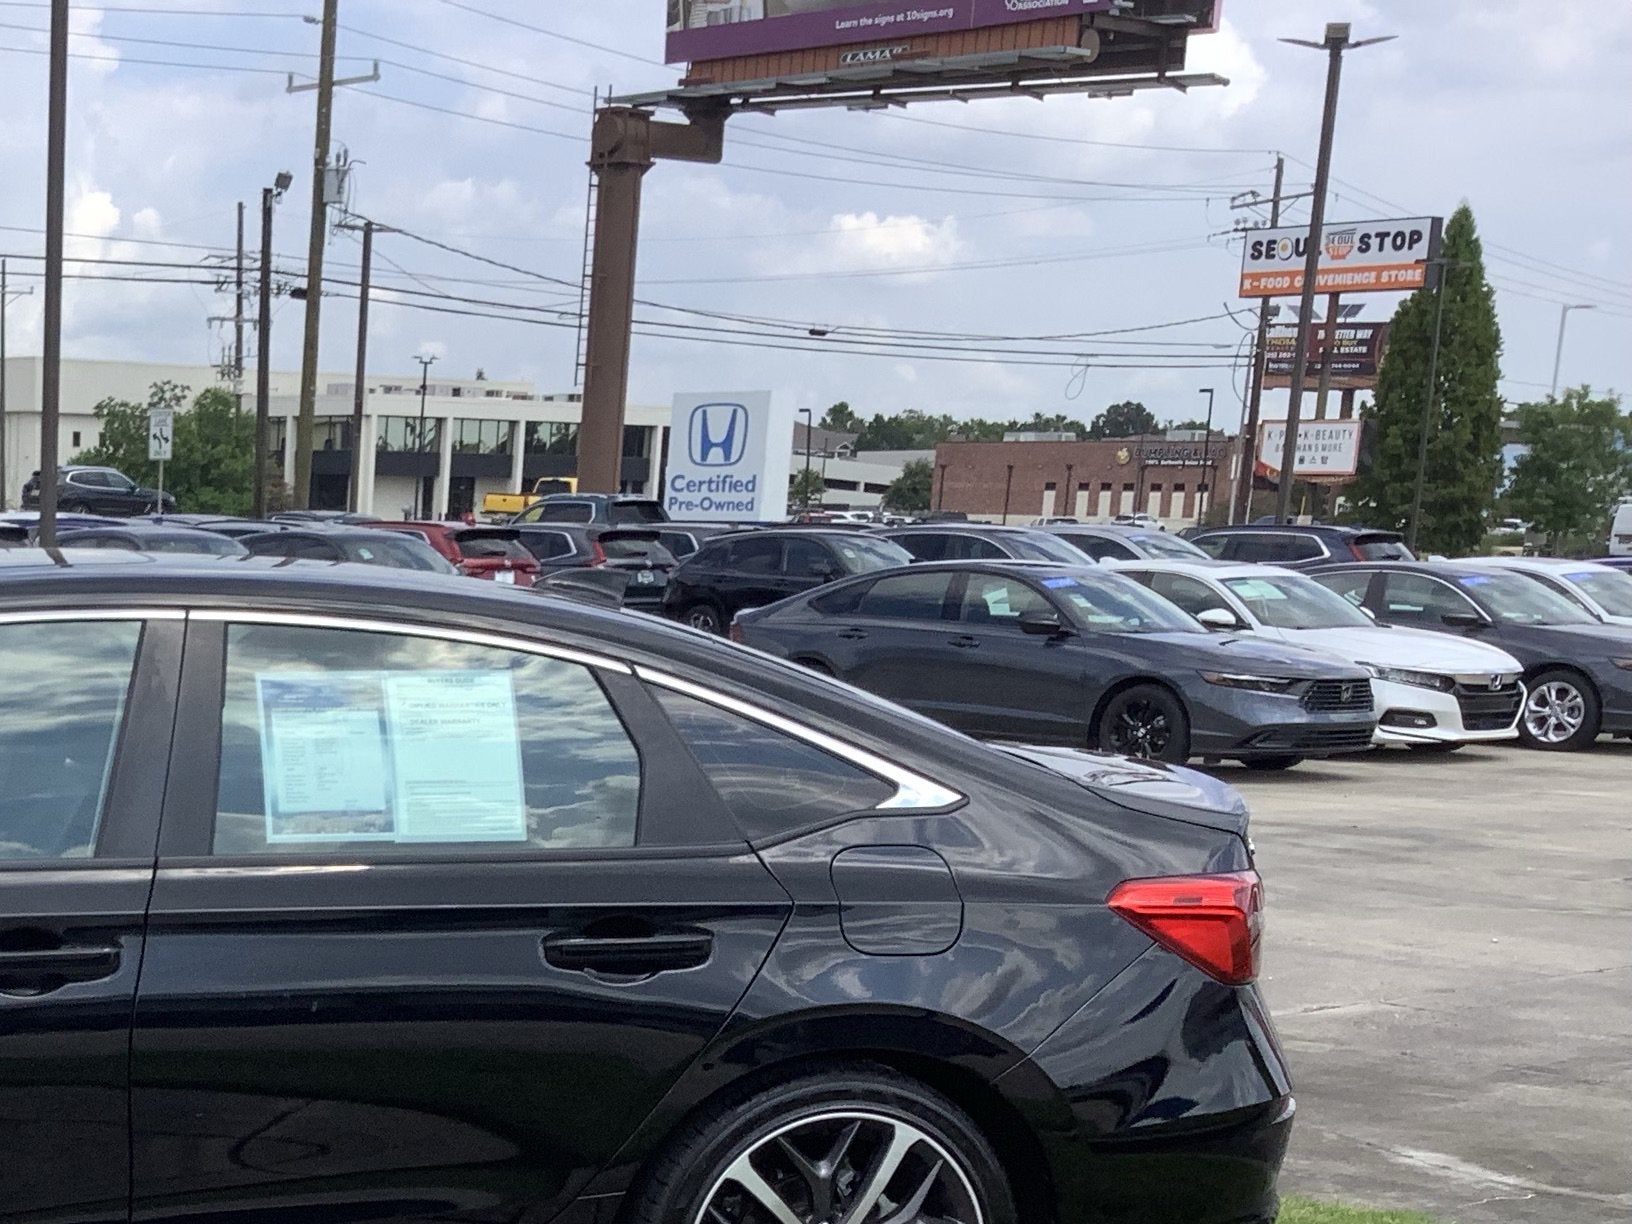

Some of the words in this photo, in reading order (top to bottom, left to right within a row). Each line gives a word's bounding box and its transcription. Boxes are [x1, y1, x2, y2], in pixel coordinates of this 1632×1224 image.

[835, 20, 858, 29] Learn
[860, 17, 873, 26] the
[874, 13, 895, 26] signs
[896, 13, 905, 21] at
[906, 8, 954, 22] 10signs.org
[1250, 236, 1322, 261] SEOU
[1357, 230, 1423, 253] STOP
[1242, 276, 1290, 290] K-FOOD
[1294, 271, 1377, 288] CVENIENCE
[1380, 269, 1422, 283] STORE
[670, 474, 757, 493] Certified
[668, 496, 755, 511] Pre-Owned
